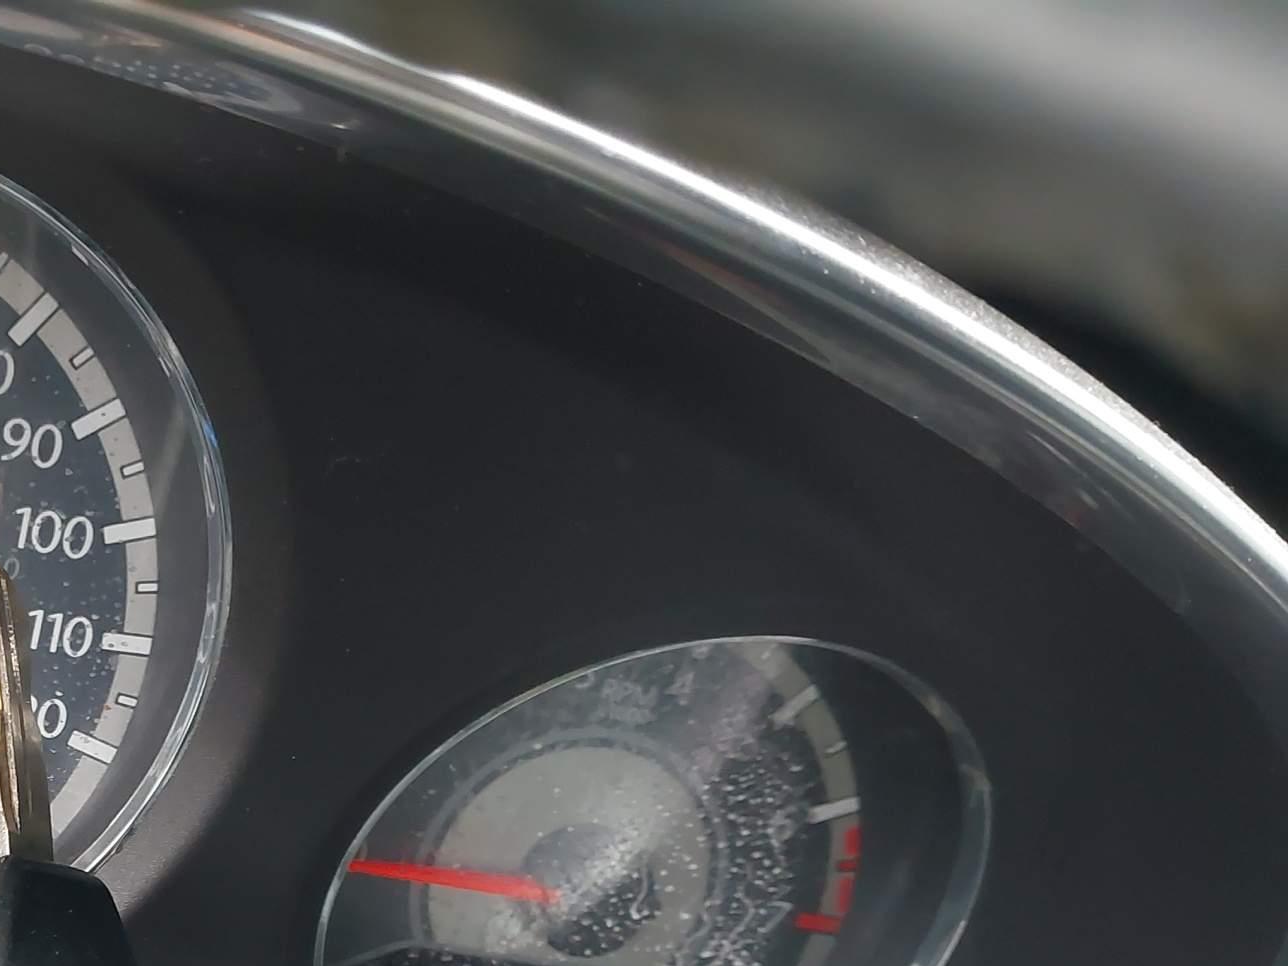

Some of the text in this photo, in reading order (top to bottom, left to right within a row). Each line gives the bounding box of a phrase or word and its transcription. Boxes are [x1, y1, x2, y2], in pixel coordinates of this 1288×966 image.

[0, 417, 62, 469] 90
[14, 507, 93, 559] 100
[28, 609, 93, 658] 110
[31, 694, 67, 739] 0
